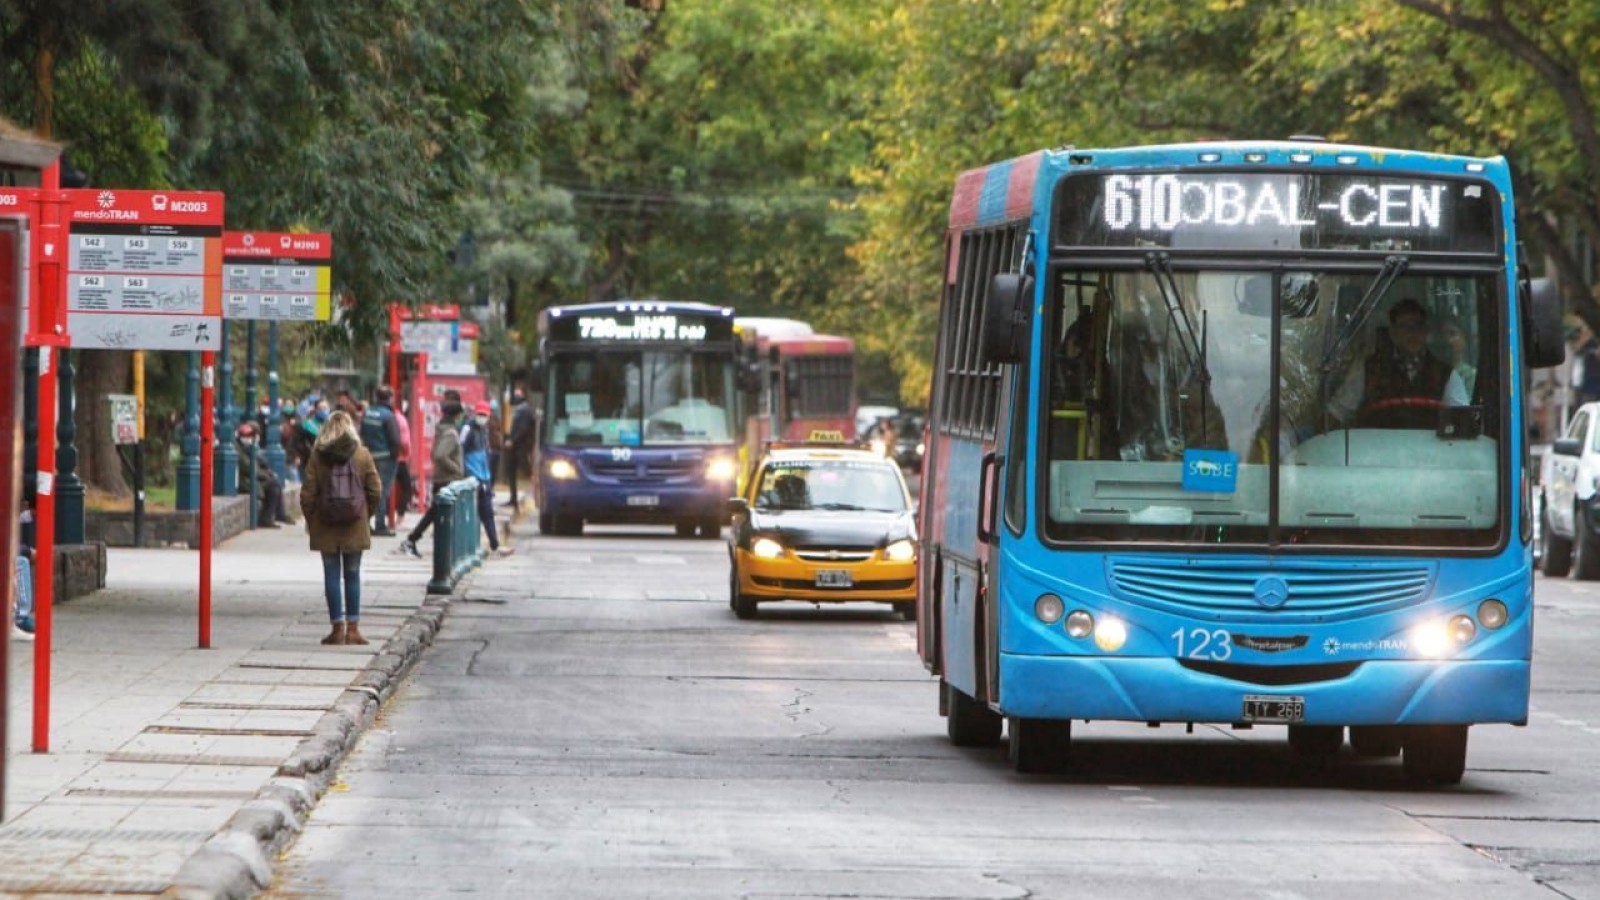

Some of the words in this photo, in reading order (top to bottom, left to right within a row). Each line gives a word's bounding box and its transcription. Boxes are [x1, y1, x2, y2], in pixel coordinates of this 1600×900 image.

[170, 201, 208, 213] M2003
[1104, 174, 1181, 230] 610
[1181, 181, 1446, 228] OBAL-CEN
[73, 209, 139, 220] mendoTRAN
[84, 238, 100, 247] 542
[172, 240, 188, 249] 550
[84, 276, 100, 286] 562
[611, 447, 632, 461] 90
[1189, 460, 1233, 477] SUBE
[1171, 627, 1232, 661] 123
[1244, 701, 1269, 718] LTY
